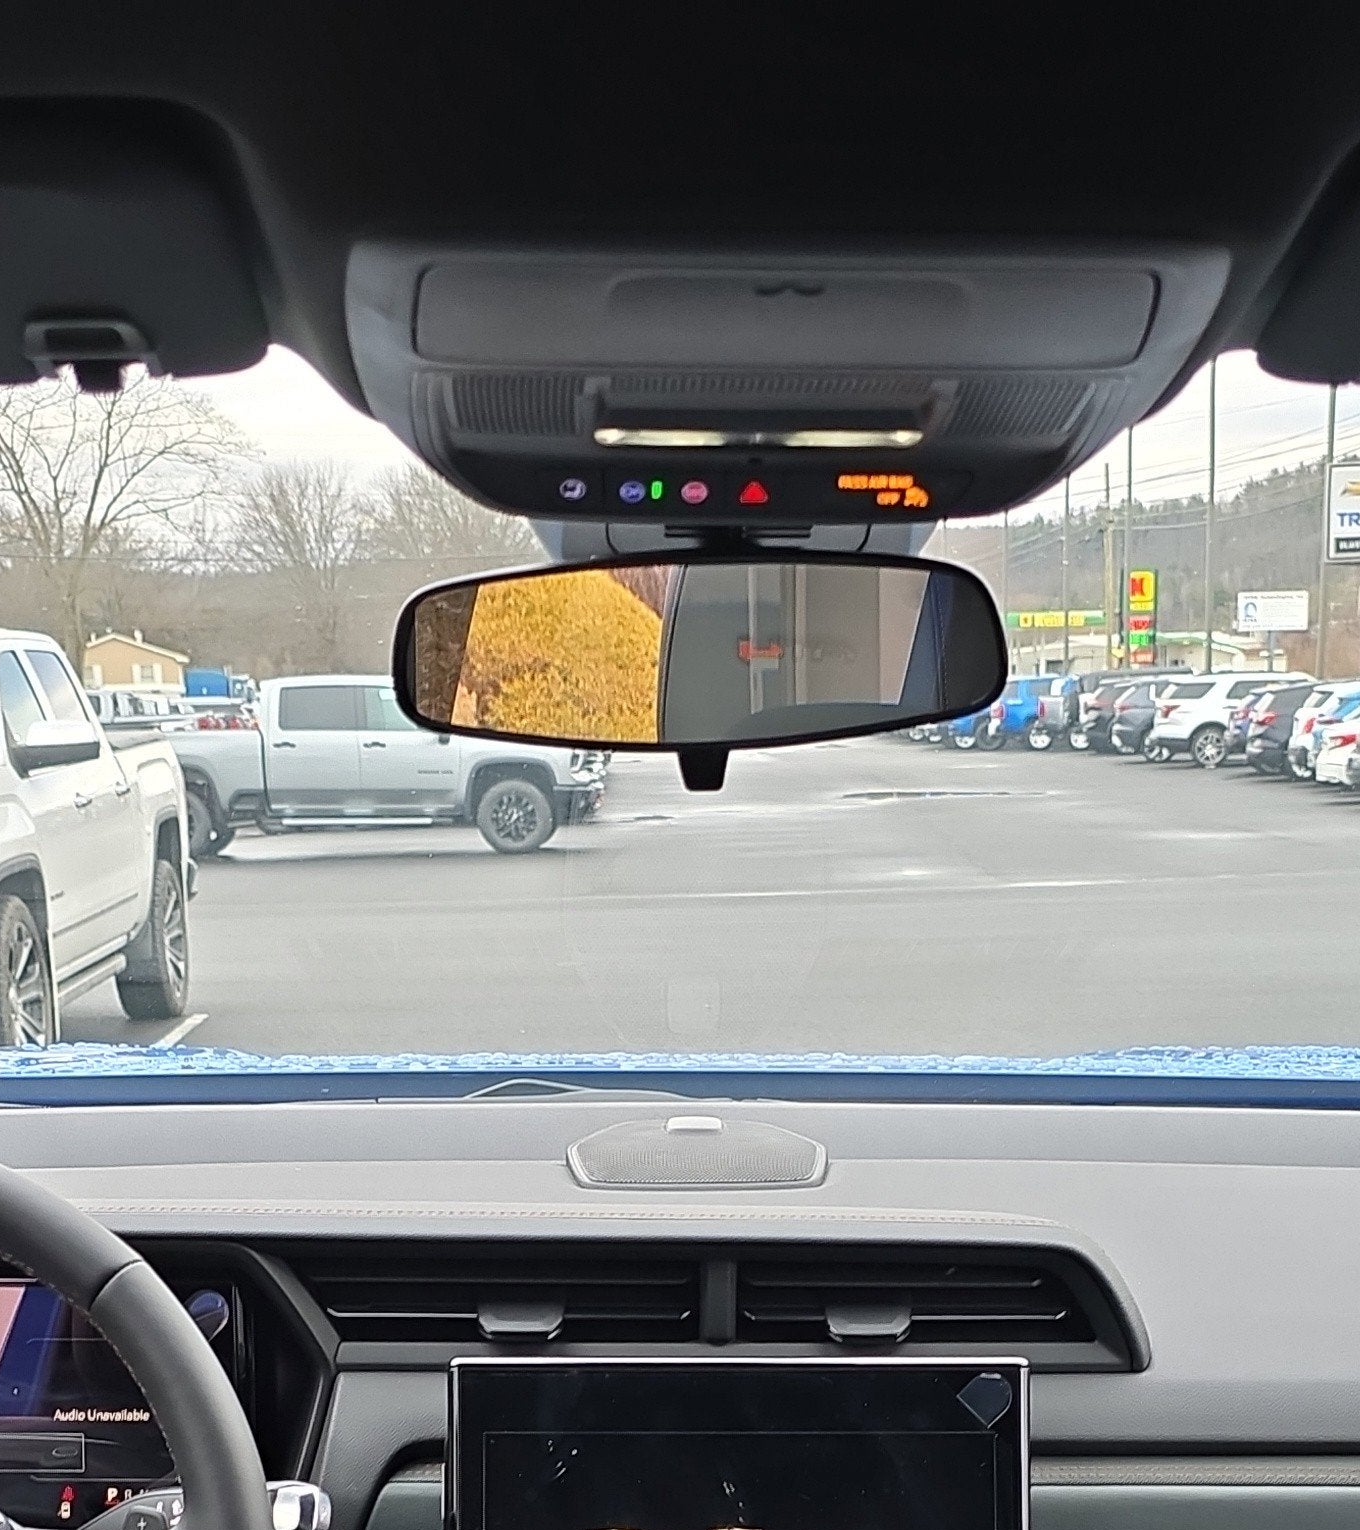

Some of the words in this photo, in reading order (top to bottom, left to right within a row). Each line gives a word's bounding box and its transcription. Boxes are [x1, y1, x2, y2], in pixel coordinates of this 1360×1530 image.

[54, 1409, 85, 1421] Audio
[87, 1409, 150, 1421] Unavailable
[107, 1488, 118, 1501] P
